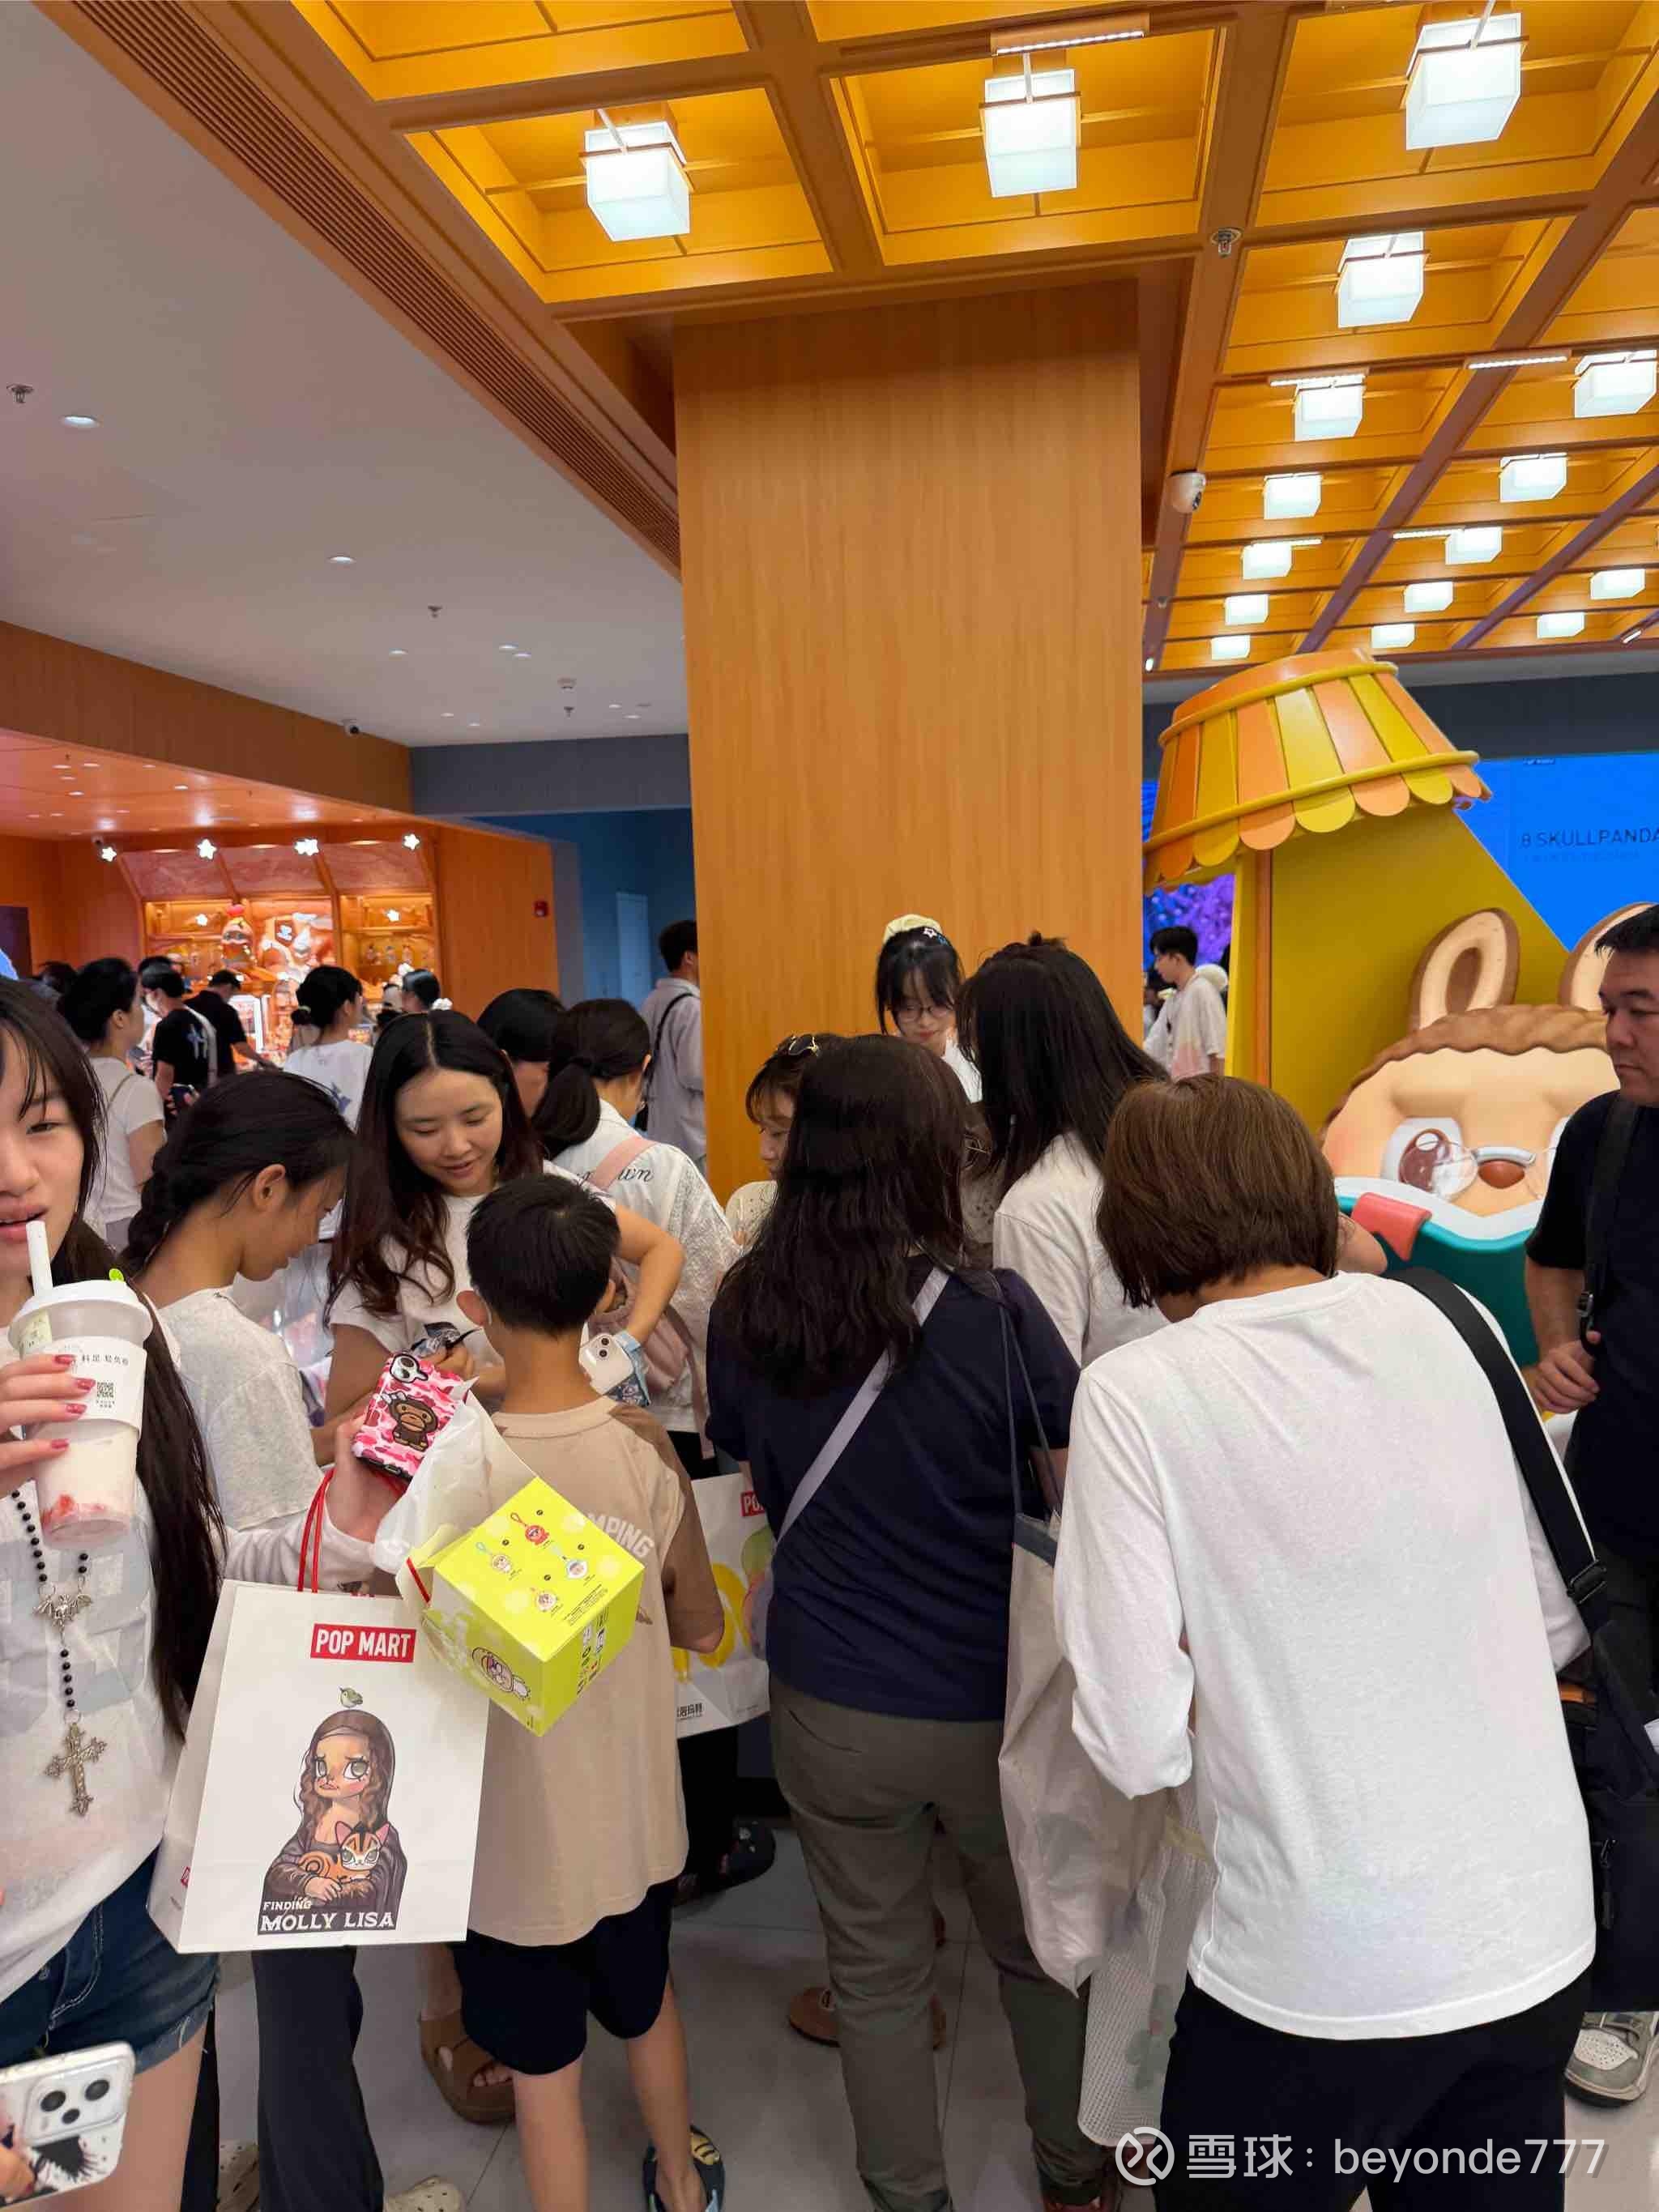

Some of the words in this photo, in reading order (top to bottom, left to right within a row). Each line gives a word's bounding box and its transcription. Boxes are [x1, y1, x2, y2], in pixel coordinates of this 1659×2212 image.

[744, 1494, 765, 1514] PO
[315, 1628, 354, 1655] POP
[358, 1630, 412, 1658] MART
[262, 1899, 313, 1911] FINDING
[260, 1912, 336, 1932] MOLLY
[343, 1912, 395, 1929] LISA
